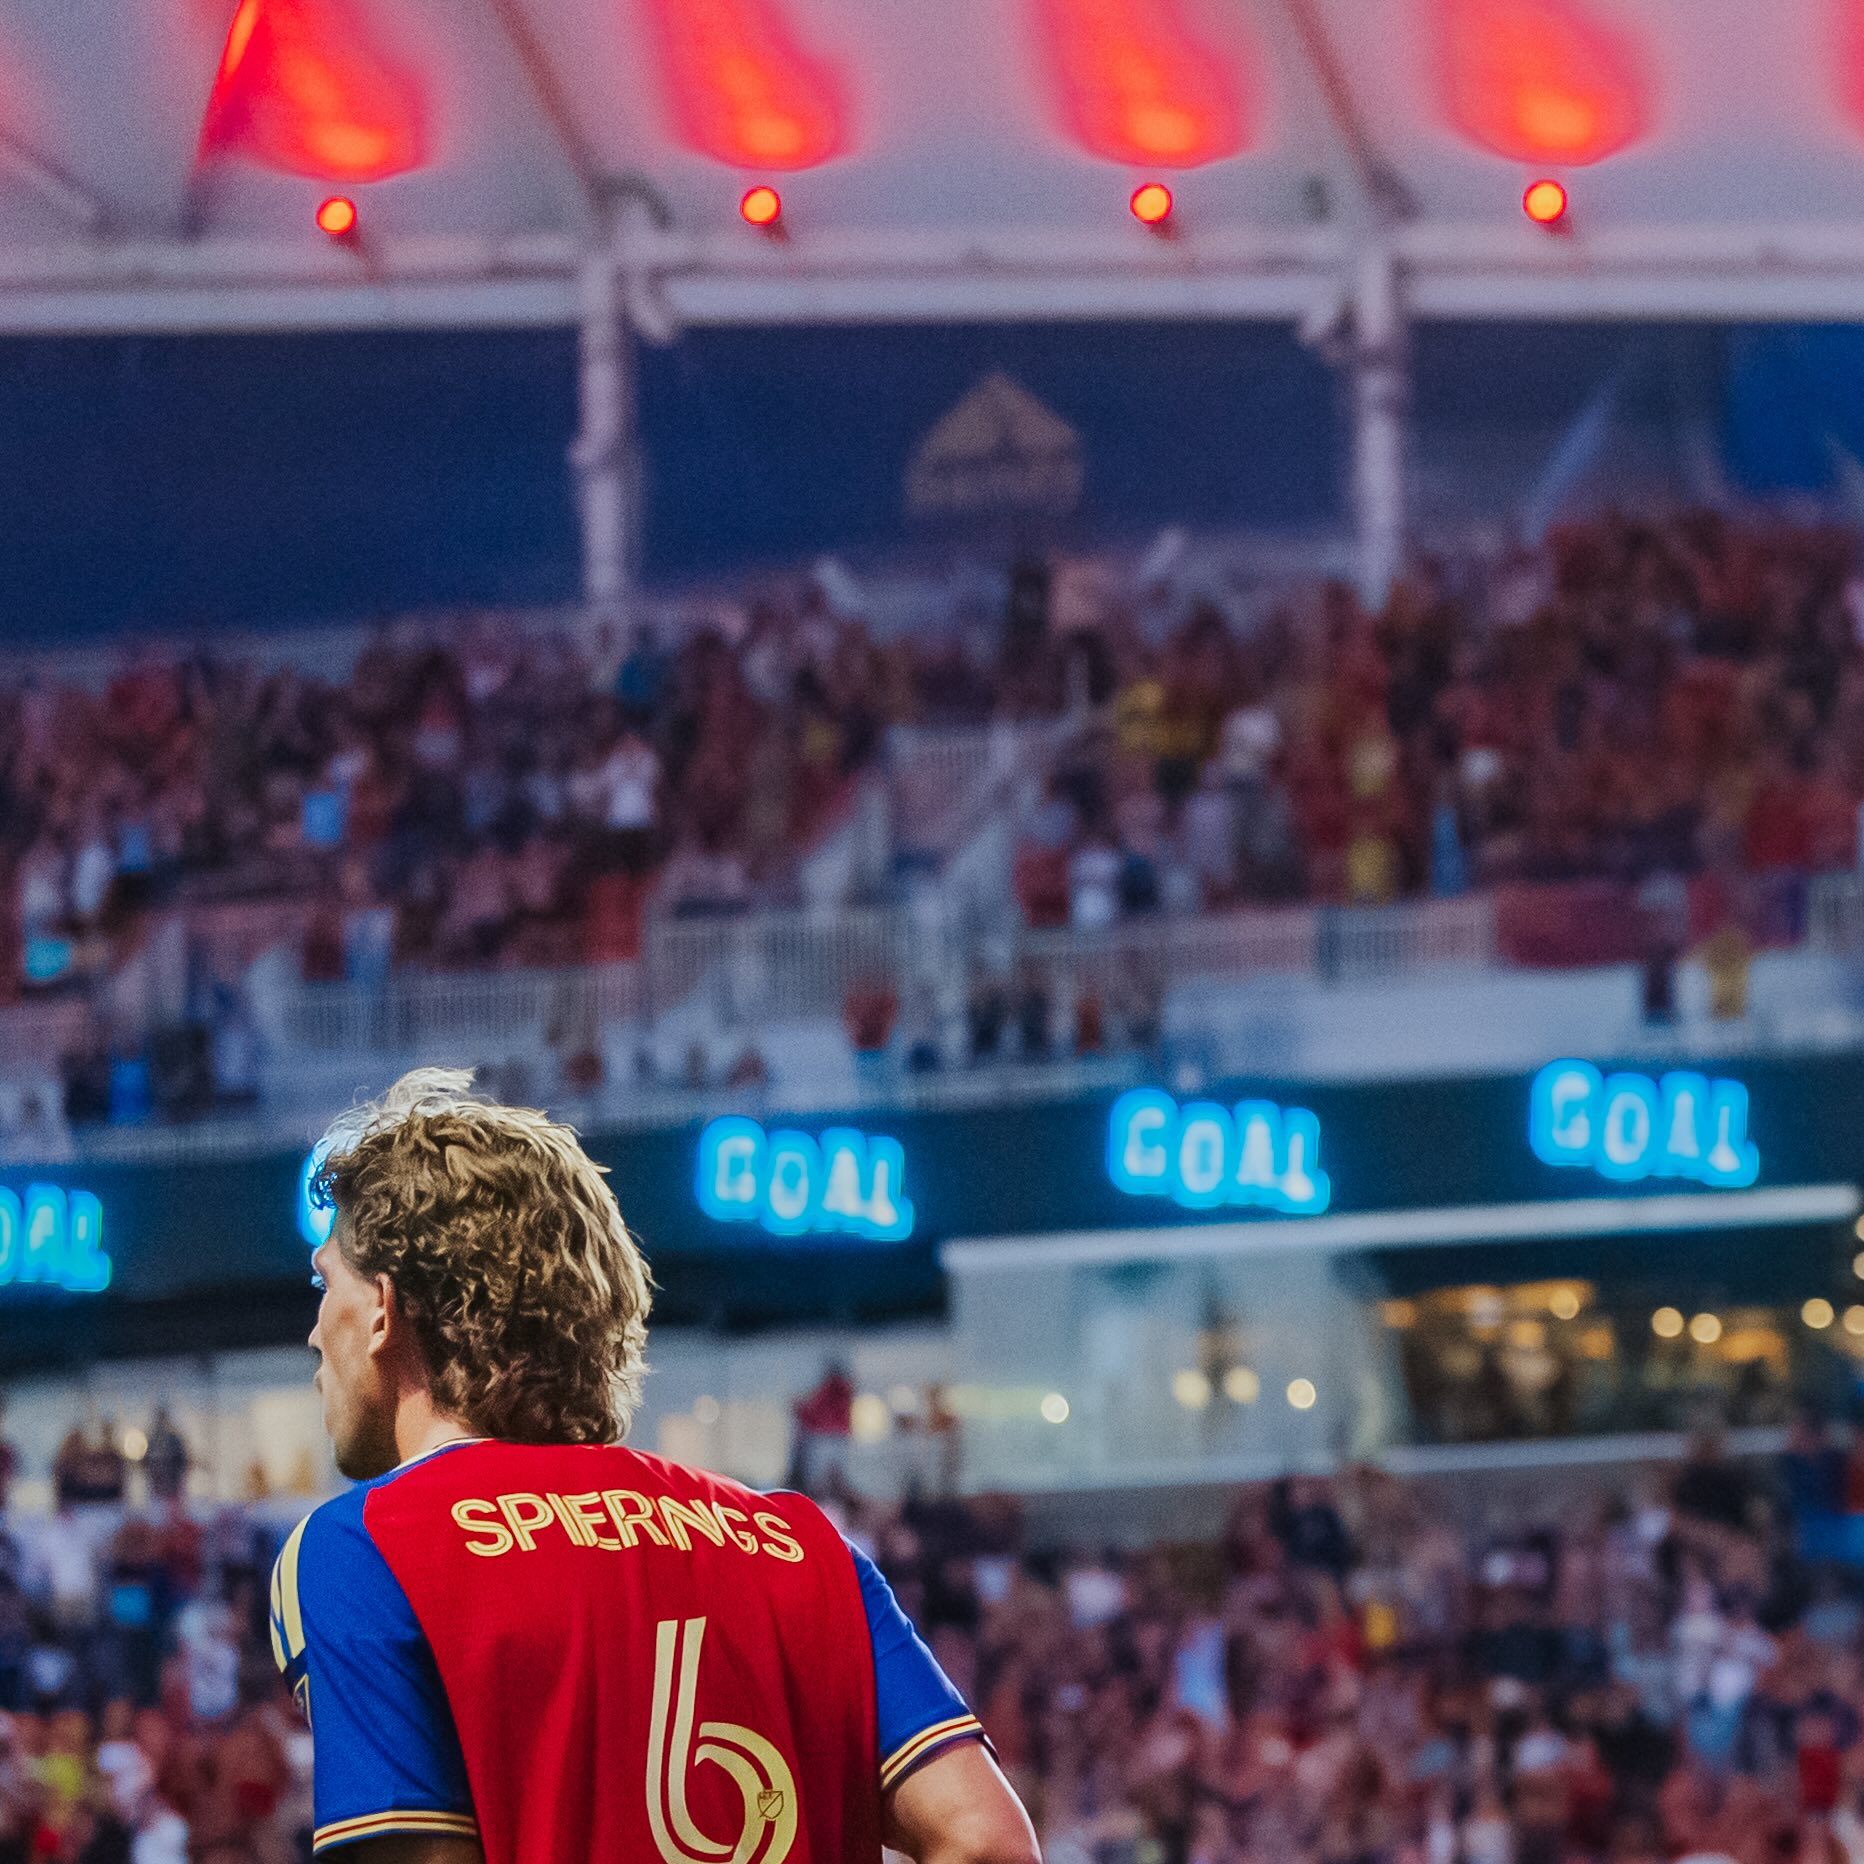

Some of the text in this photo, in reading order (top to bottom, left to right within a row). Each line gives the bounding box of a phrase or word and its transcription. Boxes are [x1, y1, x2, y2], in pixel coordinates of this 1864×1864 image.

[698, 1118, 912, 1239] GOAL
[1111, 1090, 1329, 1214] GOAL
[1532, 1061, 1757, 1186] GOAL
